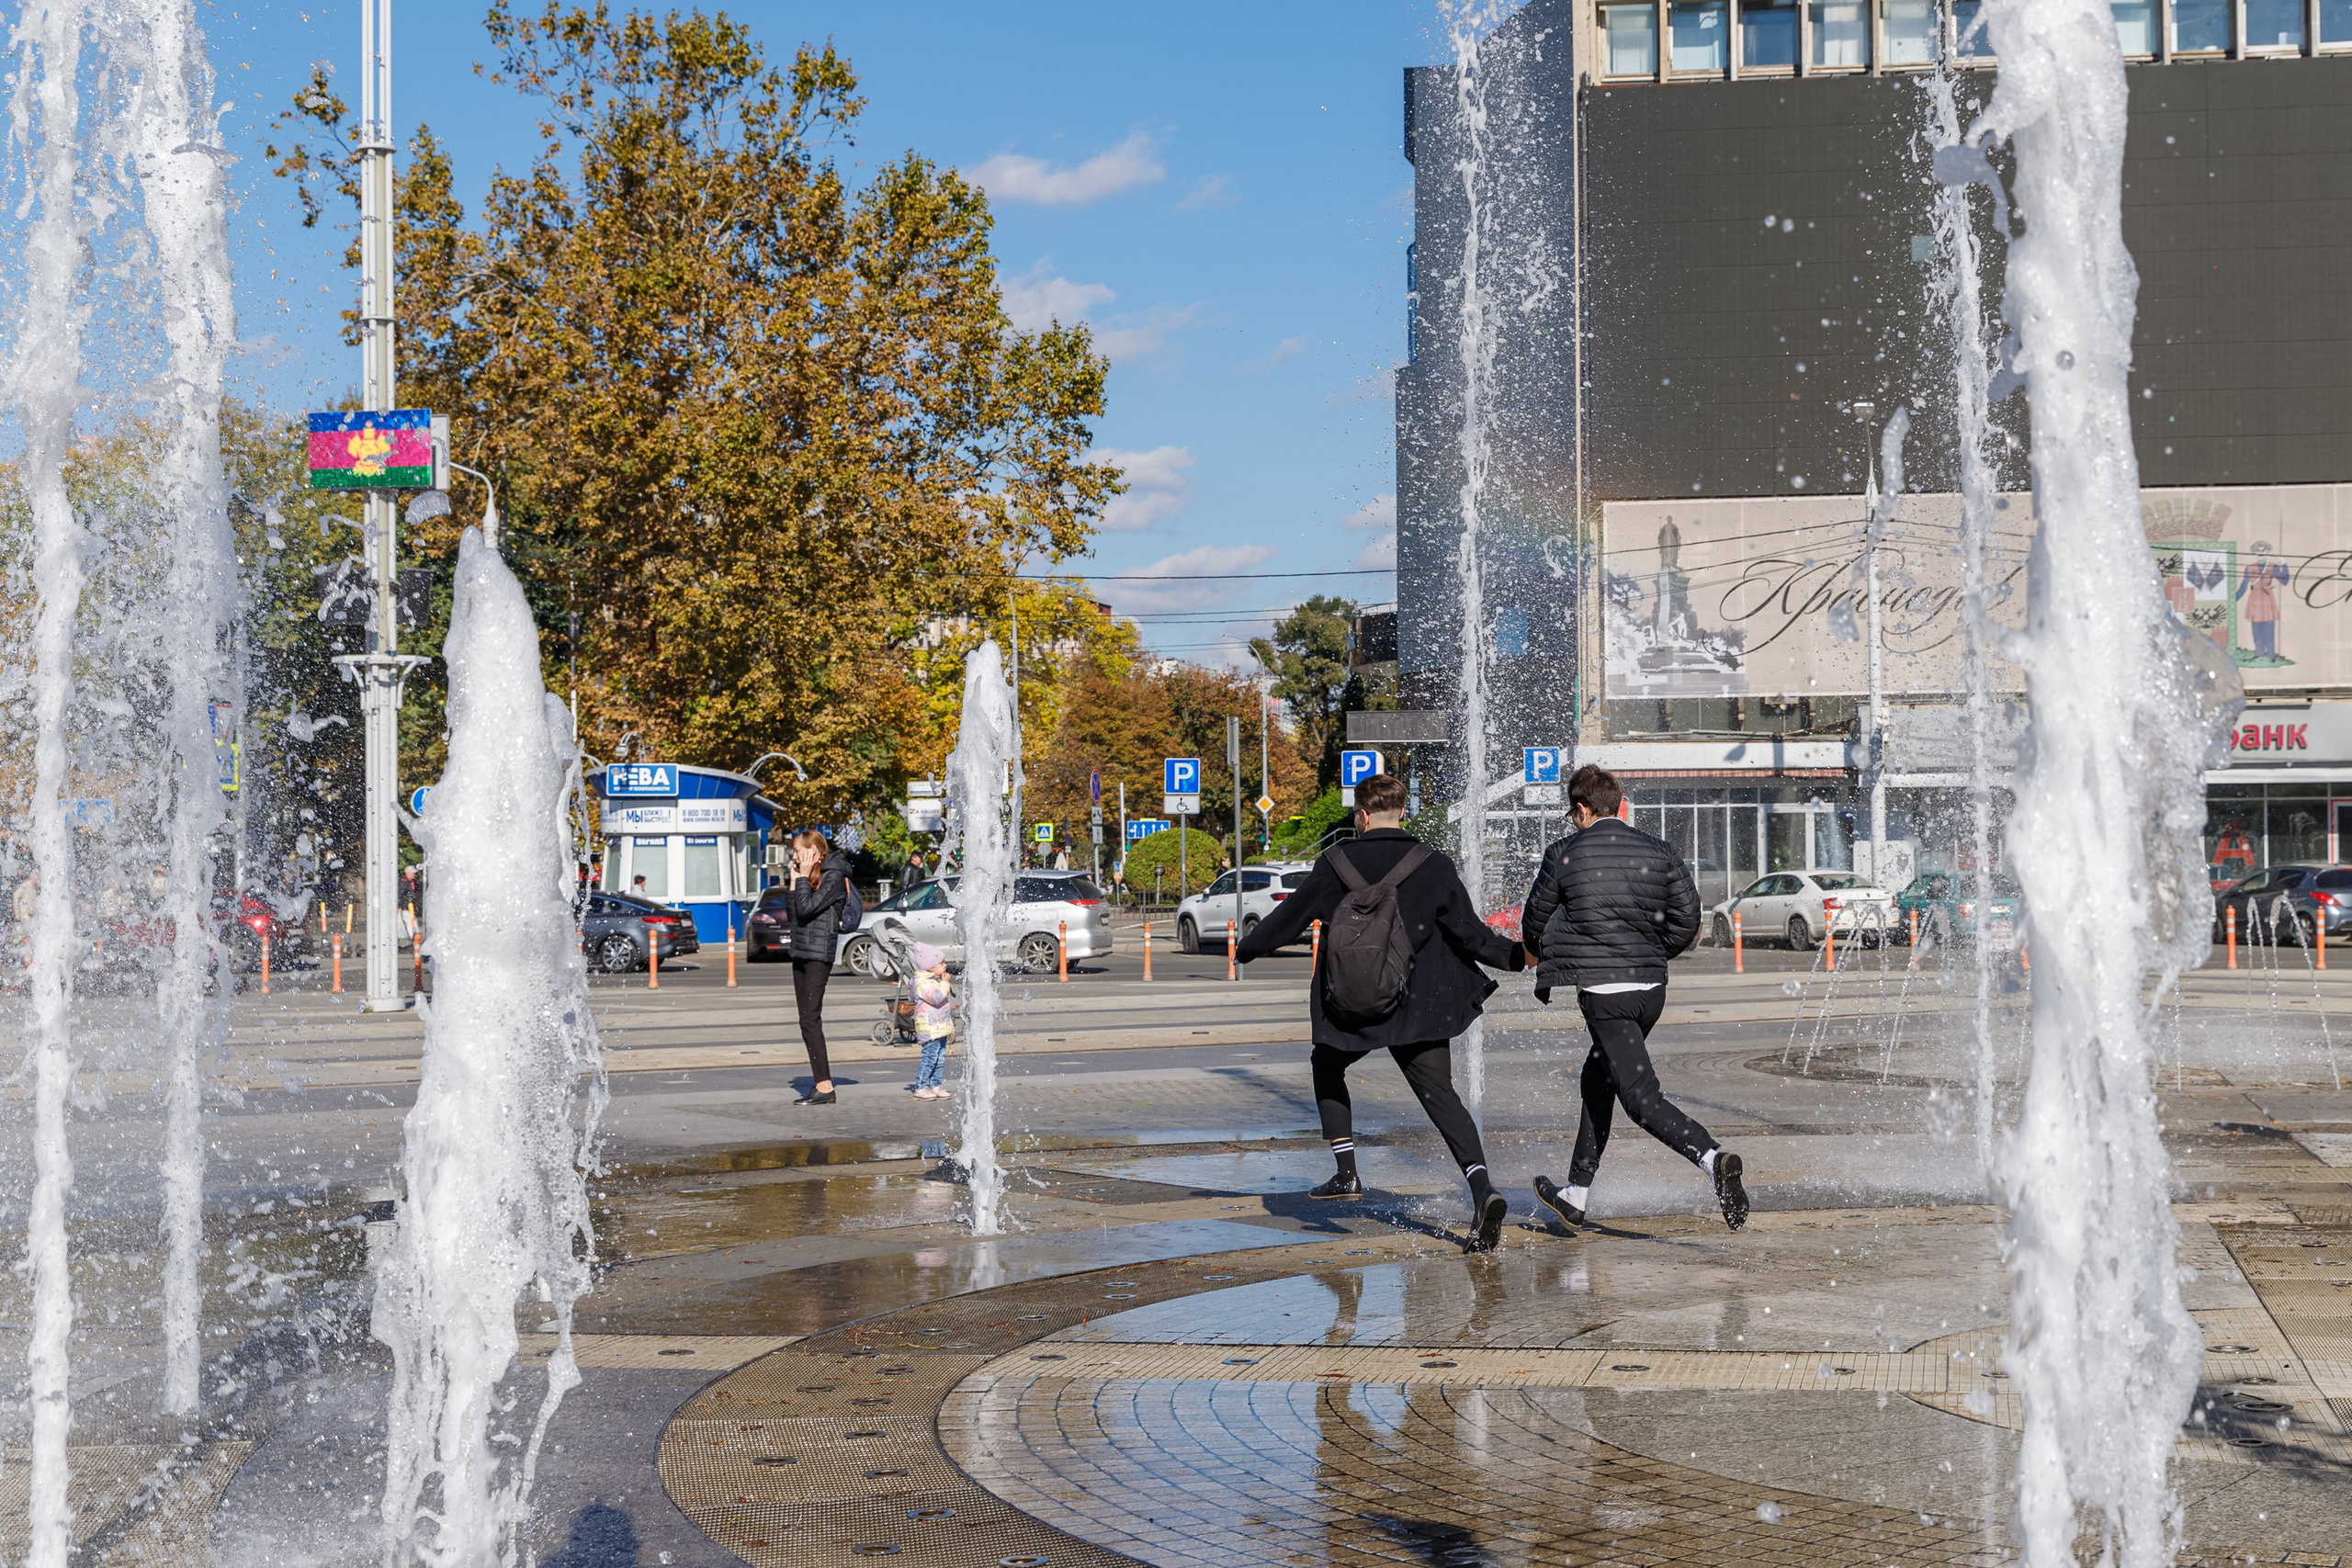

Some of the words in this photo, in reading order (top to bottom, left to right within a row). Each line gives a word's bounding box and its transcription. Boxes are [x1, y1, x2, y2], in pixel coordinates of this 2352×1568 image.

[1174, 762, 1193, 790] P
[1351, 755, 1371, 783] P
[1533, 750, 1553, 779] P
